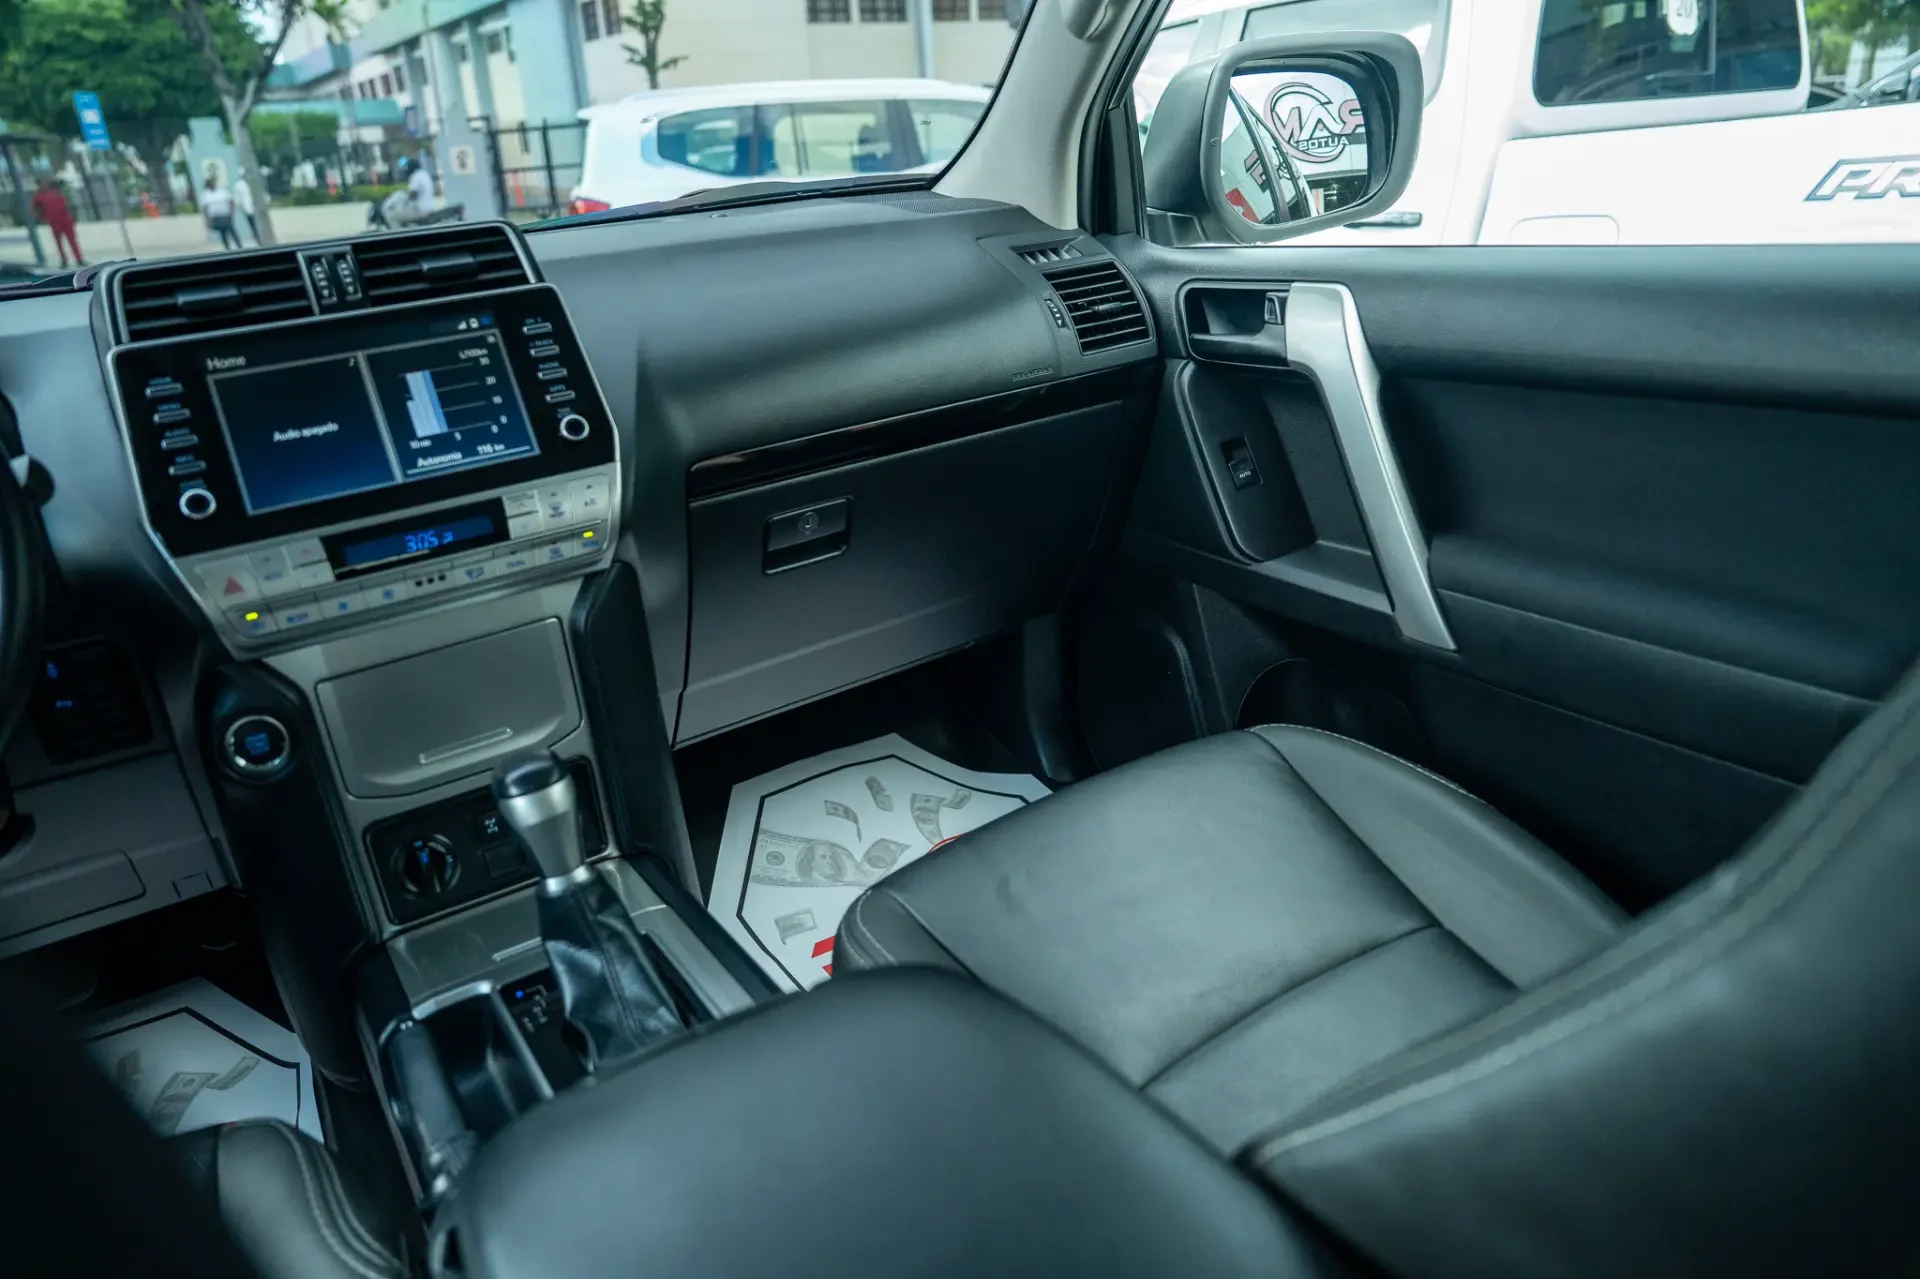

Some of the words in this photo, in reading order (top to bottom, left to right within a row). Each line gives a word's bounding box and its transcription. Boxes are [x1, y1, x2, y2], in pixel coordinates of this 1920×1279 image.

[206, 355, 247, 370] Home
[485, 376, 497, 385] 20
[500, 414, 508, 424] 0
[272, 428, 301, 442] Audio
[302, 421, 340, 438] apagado
